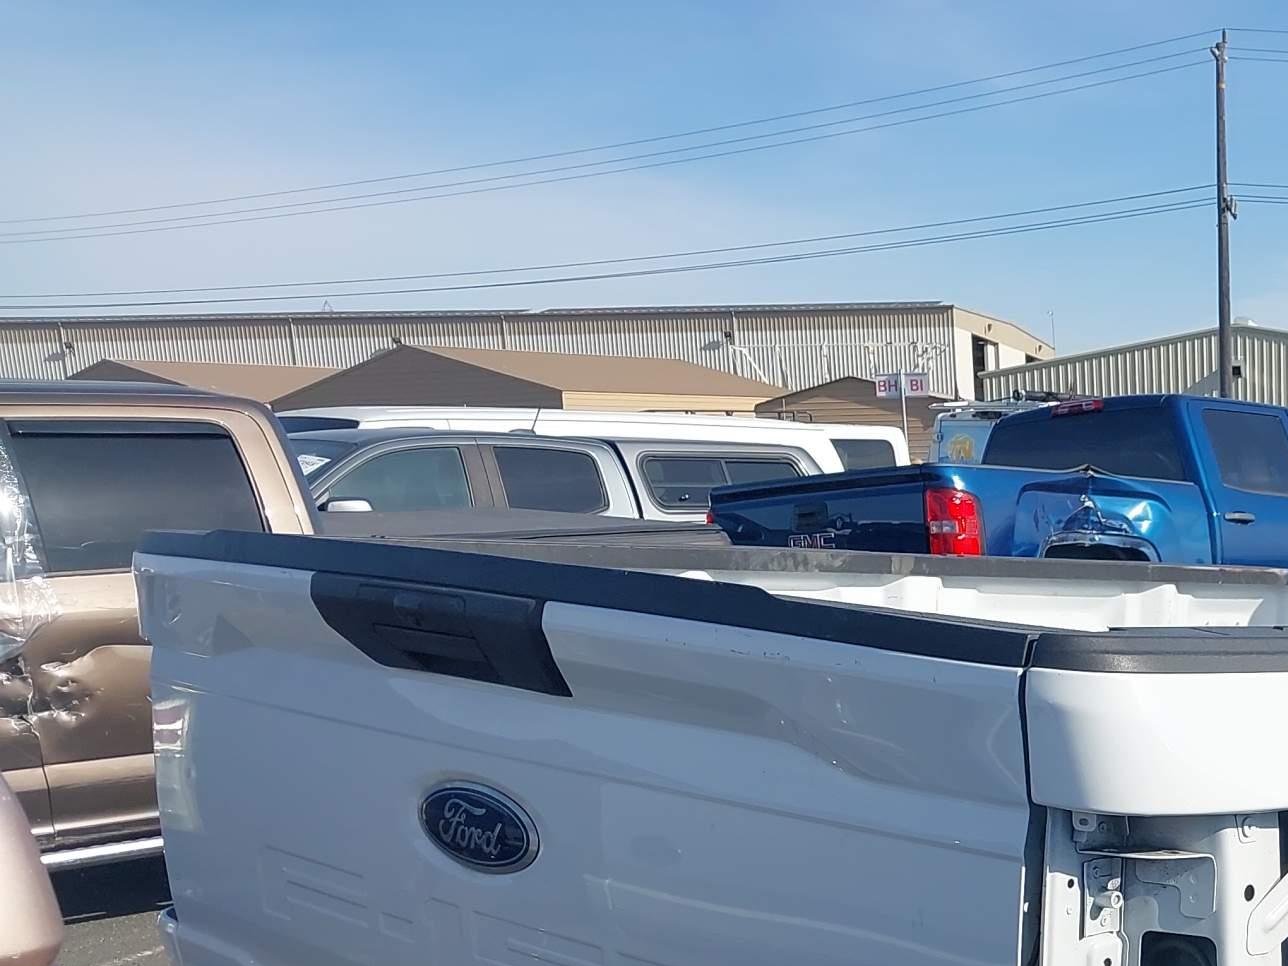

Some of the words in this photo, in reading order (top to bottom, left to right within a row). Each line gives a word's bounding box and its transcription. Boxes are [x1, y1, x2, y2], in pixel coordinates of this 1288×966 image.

[878, 380, 898, 393] BH
[788, 532, 836, 549] GMC
[439, 798, 502, 855] Ford
